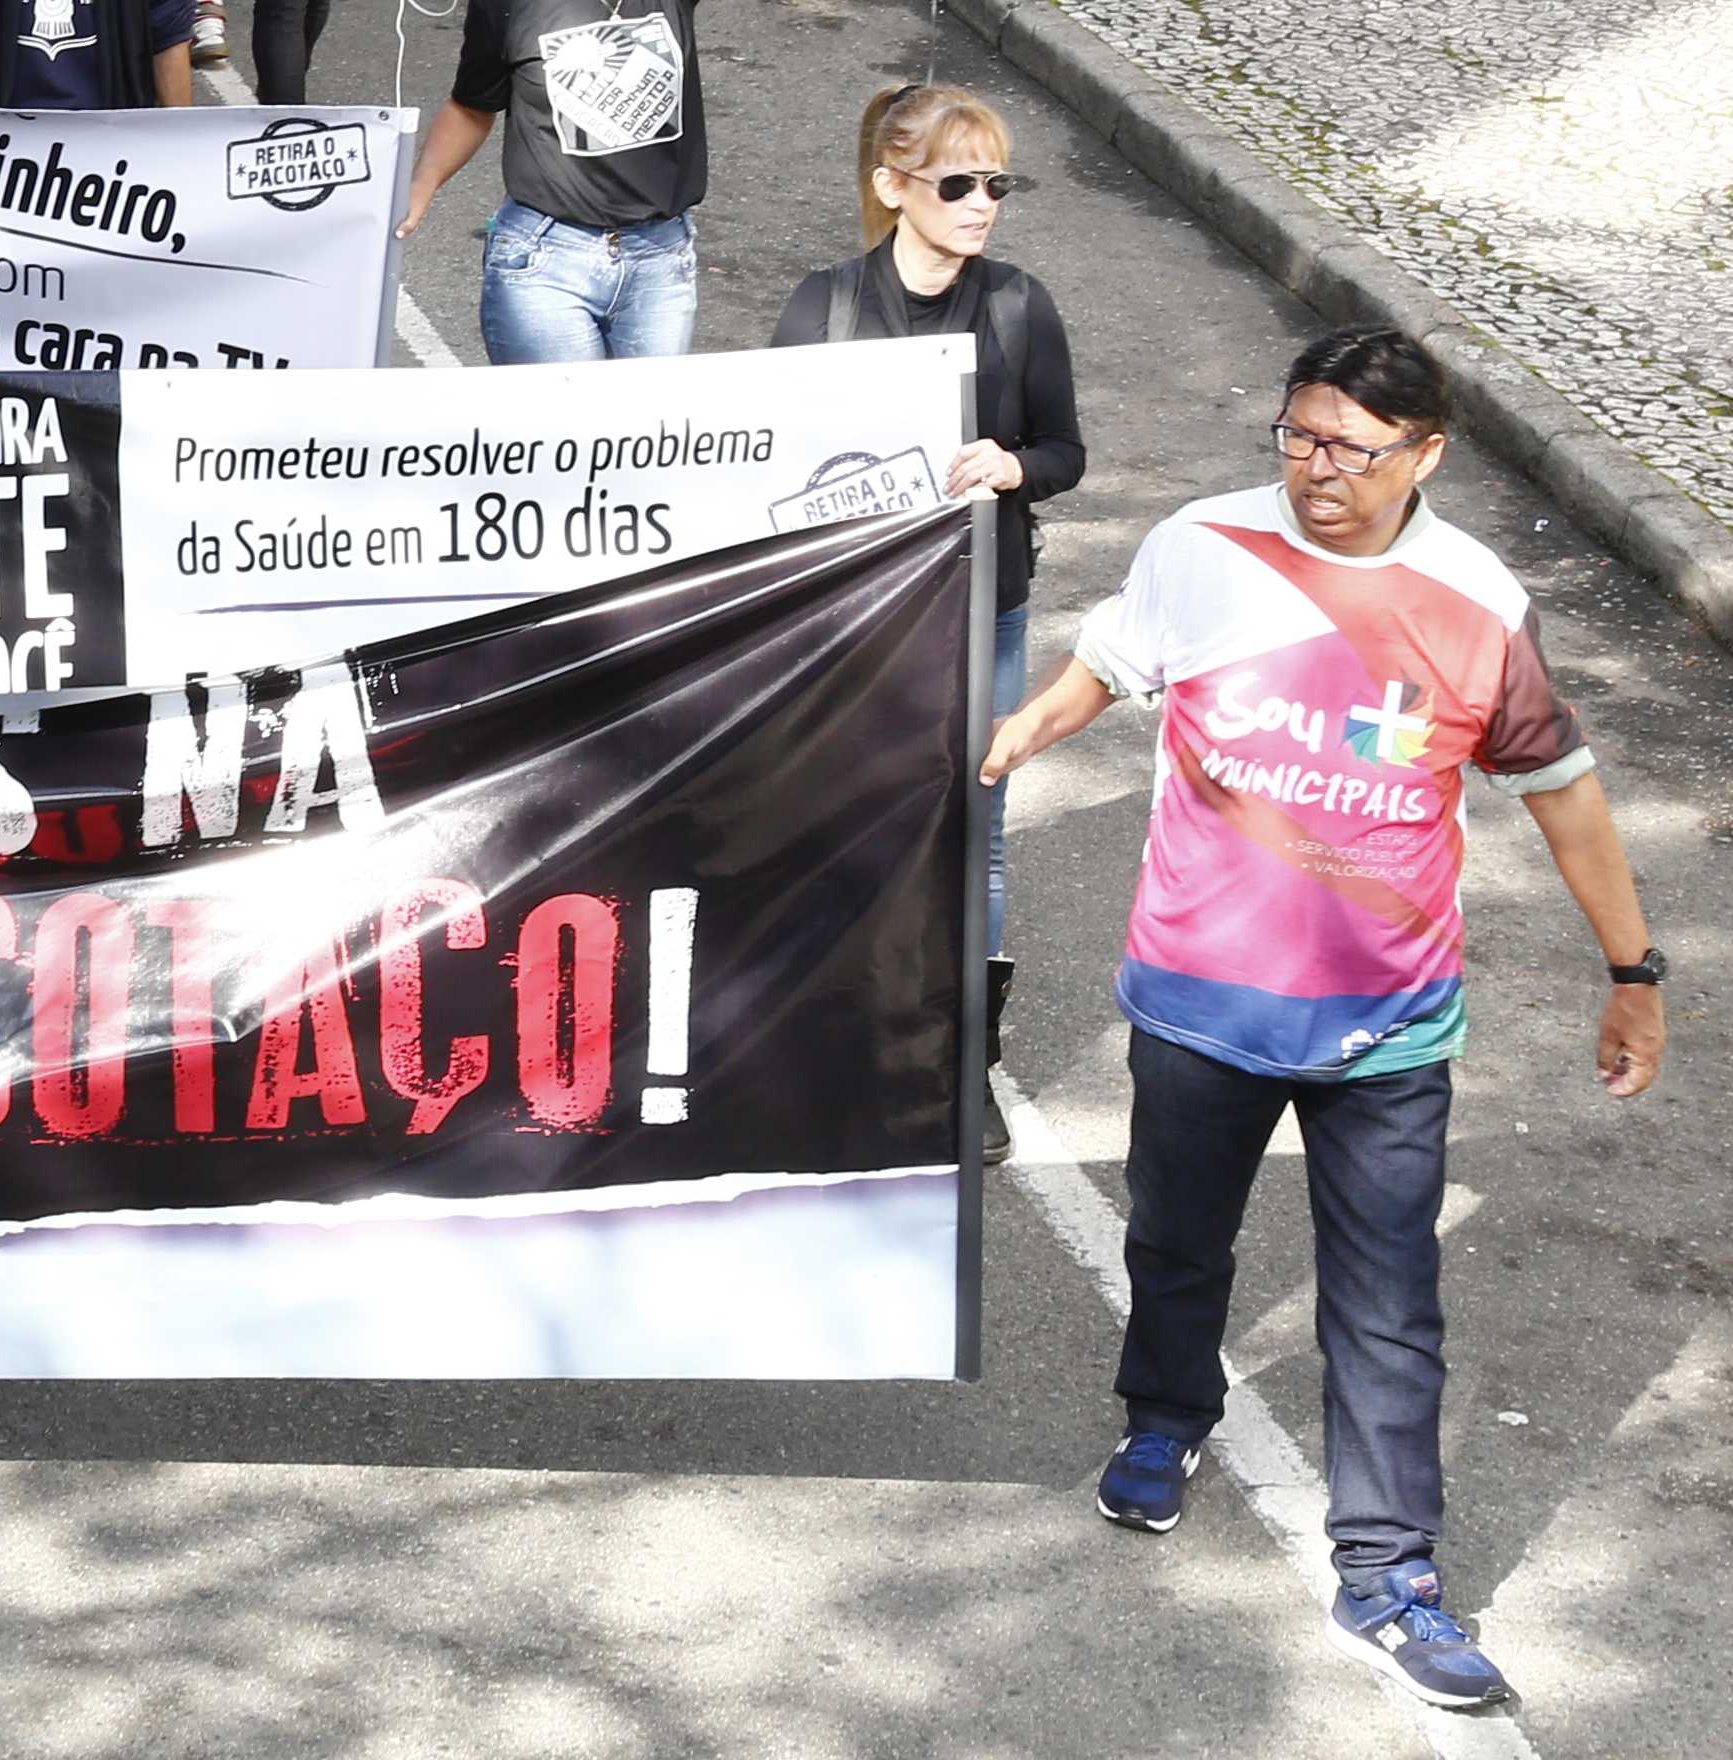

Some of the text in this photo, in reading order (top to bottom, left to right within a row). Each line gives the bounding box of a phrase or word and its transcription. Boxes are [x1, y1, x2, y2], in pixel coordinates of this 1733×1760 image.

[597, 86, 625, 113] POR
[246, 157, 347, 190] PACOTAÇO
[255, 136, 336, 168] RETIRA O
[175, 416, 775, 485] Prometeu resolver o problema
[803, 476, 875, 524] RETIRA
[877, 468, 896, 495] O
[177, 486, 673, 576] da Saúde em 180 dias
[1204, 671, 1325, 754] Sou
[138, 649, 393, 845] NA
[1200, 748, 1427, 823] MUNICIPAIS
[1297, 840, 1361, 863] SERVIÇO
